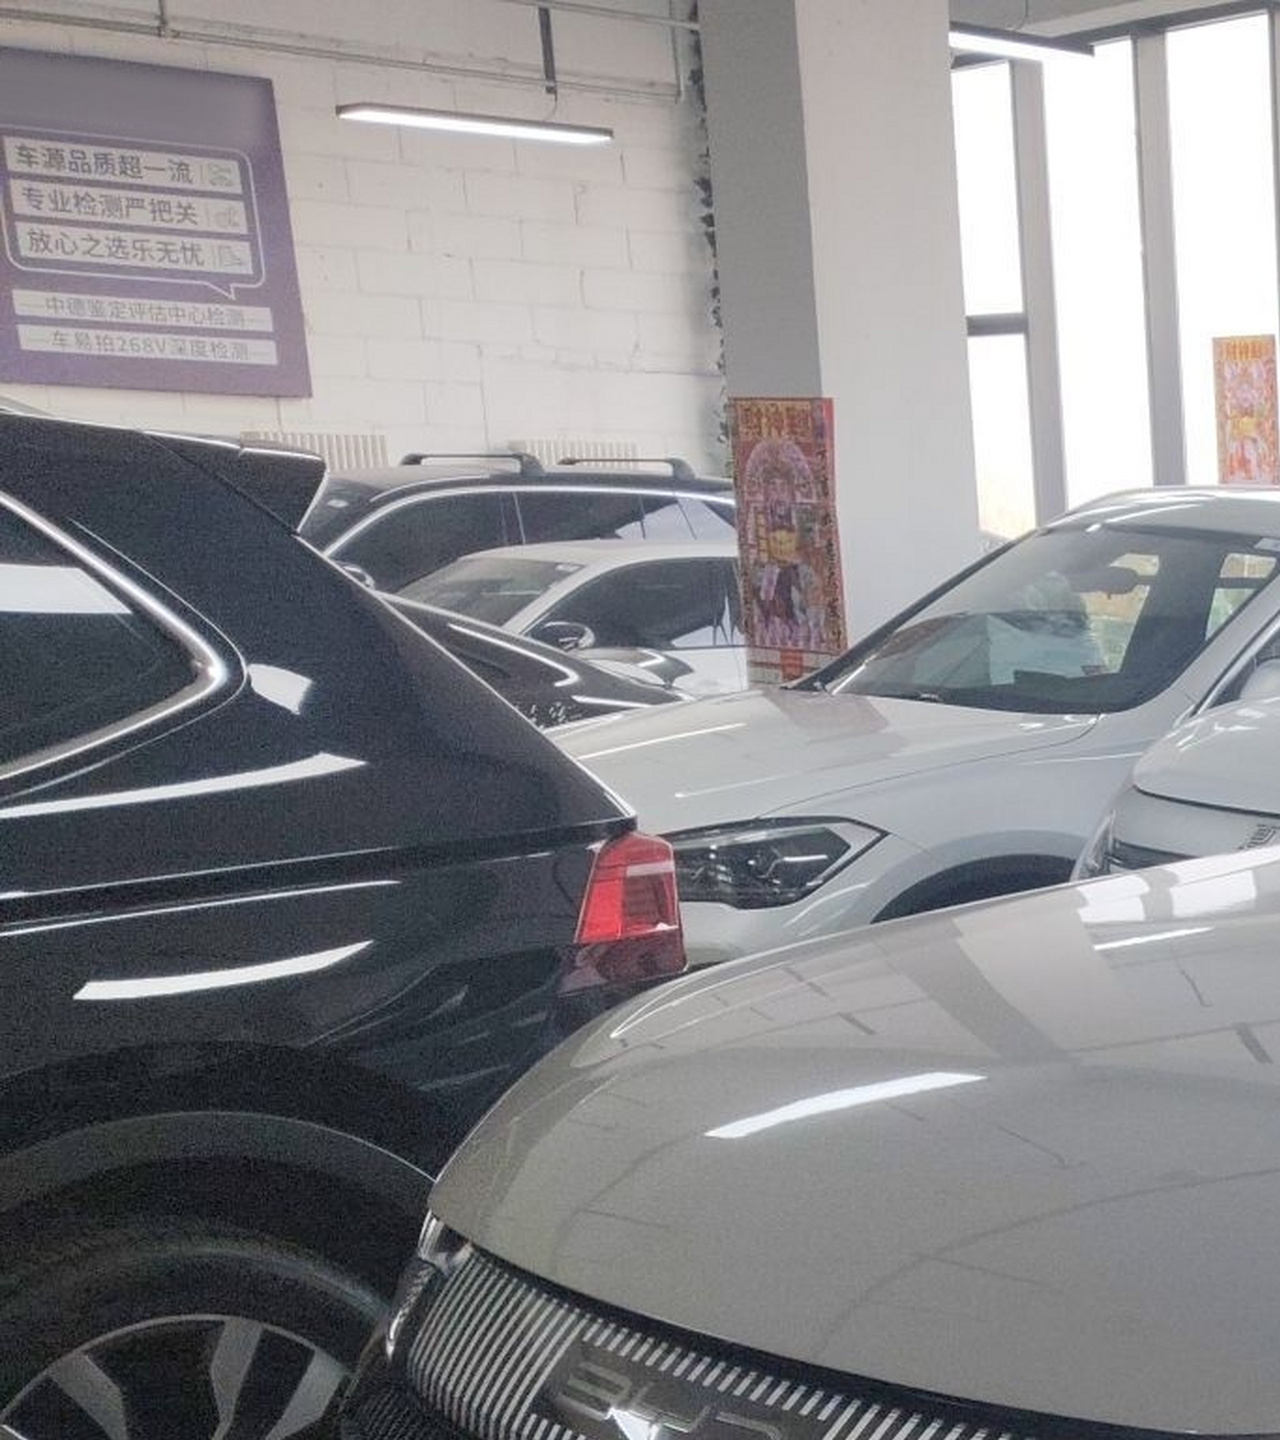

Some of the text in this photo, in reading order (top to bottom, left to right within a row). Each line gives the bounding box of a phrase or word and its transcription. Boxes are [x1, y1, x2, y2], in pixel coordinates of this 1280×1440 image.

[16, 144, 193, 184] 车源品质超一流
[22, 187, 198, 225] 专业检测严把关
[28, 229, 205, 267] 放心之选乐无忧
